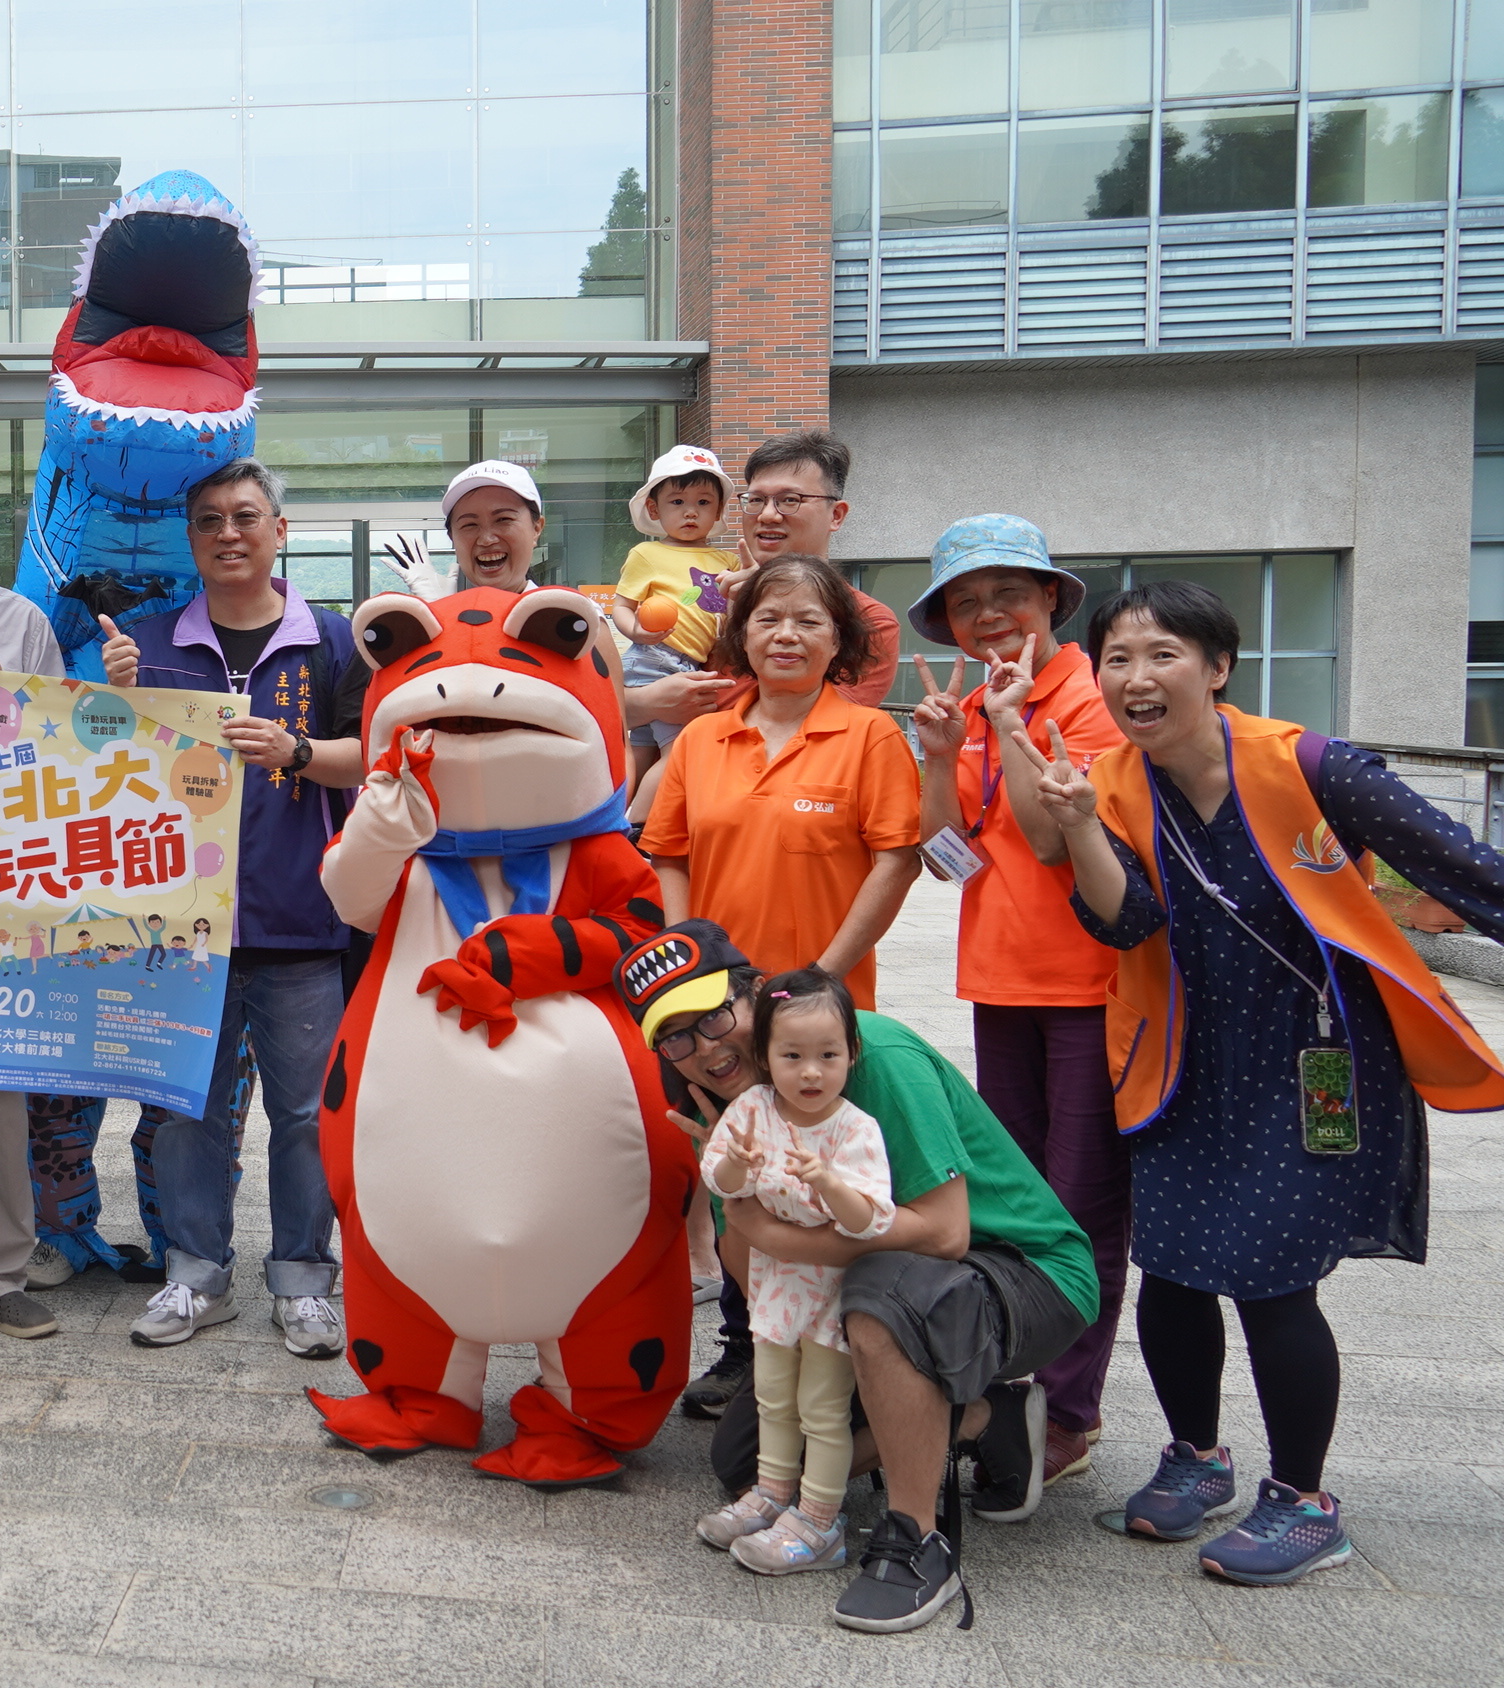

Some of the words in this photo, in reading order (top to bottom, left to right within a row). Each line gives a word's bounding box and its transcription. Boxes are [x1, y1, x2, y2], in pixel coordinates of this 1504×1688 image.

[484, 466, 510, 476] Liao
[275, 671, 290, 706] 主任
[81, 714, 128, 726] 行動玩具車
[90, 726, 118, 737] 遊戲區
[3, 749, 160, 823] 北大
[181, 774, 220, 788] 玩具拆解
[185, 786, 215, 799] 體驗區
[48, 991, 79, 1004] 09:00
[99, 990, 130, 1001] 報名方式
[36, 1011, 45, 1019] 六
[48, 1009, 78, 1022] 12:00
[95, 1043, 127, 1054] 聯絡方式
[1316, 1127, 1345, 1137] 11:04
